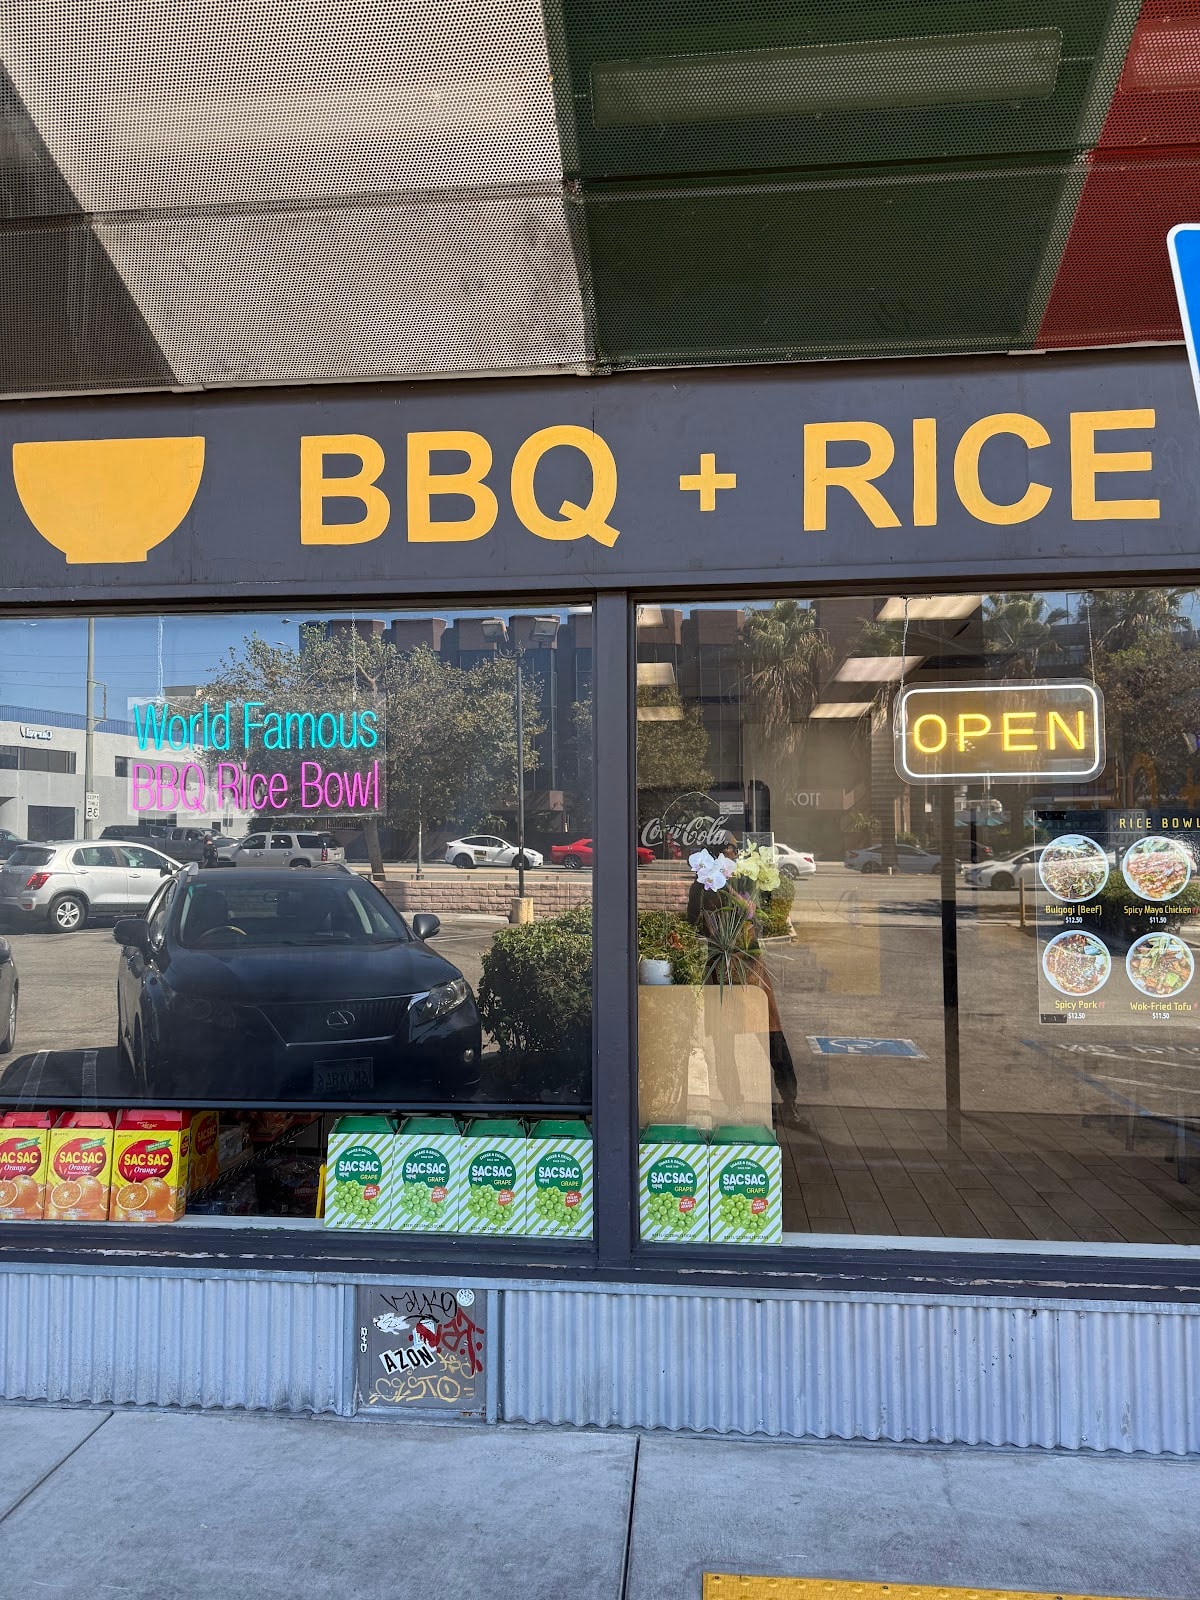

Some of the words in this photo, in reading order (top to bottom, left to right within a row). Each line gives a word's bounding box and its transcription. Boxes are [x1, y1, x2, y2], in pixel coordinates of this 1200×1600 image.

[300, 424, 620, 548] BBQ
[679, 452, 737, 512] +
[803, 408, 1161, 532] RICE
[134, 700, 230, 751] World
[243, 701, 378, 750] Famous
[912, 710, 1086, 753] OPEN
[131, 762, 206, 813] BBQ
[217, 761, 289, 810] Rice
[300, 759, 380, 809] Bowl
[1119, 817, 1152, 829] RICE
[1161, 817, 1200, 829] BOWL
[1045, 905, 1075, 915] Bulgogi
[1124, 905, 1144, 915] Spicy
[1144, 905, 1164, 915] Mayo
[1164, 905, 1192, 914] Chicken
[1065, 916, 1083, 924] $12.50
[1149, 916, 1167, 924] $11.50
[1055, 1000, 1077, 1011] Spicy
[1078, 1000, 1098, 1009] Pork
[1130, 1001, 1172, 1011] Wok-Fried
[1174, 1001, 1192, 1011] Tofu
[1067, 1012, 1086, 1020] $12.50
[1152, 1012, 1170, 1020] $11.50
[0, 1151, 15, 1164] AC
[17, 1151, 38, 1164] SAC
[59, 1151, 81, 1164] SAC
[81, 1151, 104, 1164] SAC
[124, 1153, 145, 1166] SAC
[147, 1154, 170, 1166] SAC
[4, 1164, 27, 1172] Orange
[68, 1164, 92, 1172] Orange
[133, 1166, 158, 1174] Orange
[338, 1160, 379, 1172] SACSAC
[405, 1162, 447, 1174] SACSAC
[471, 1165, 513, 1177] SACSAC
[538, 1166, 580, 1179] SACSAC
[650, 1172, 694, 1184] SACSAC
[723, 1173, 766, 1185] SACSAC
[383, 1346, 435, 1373] AZON
